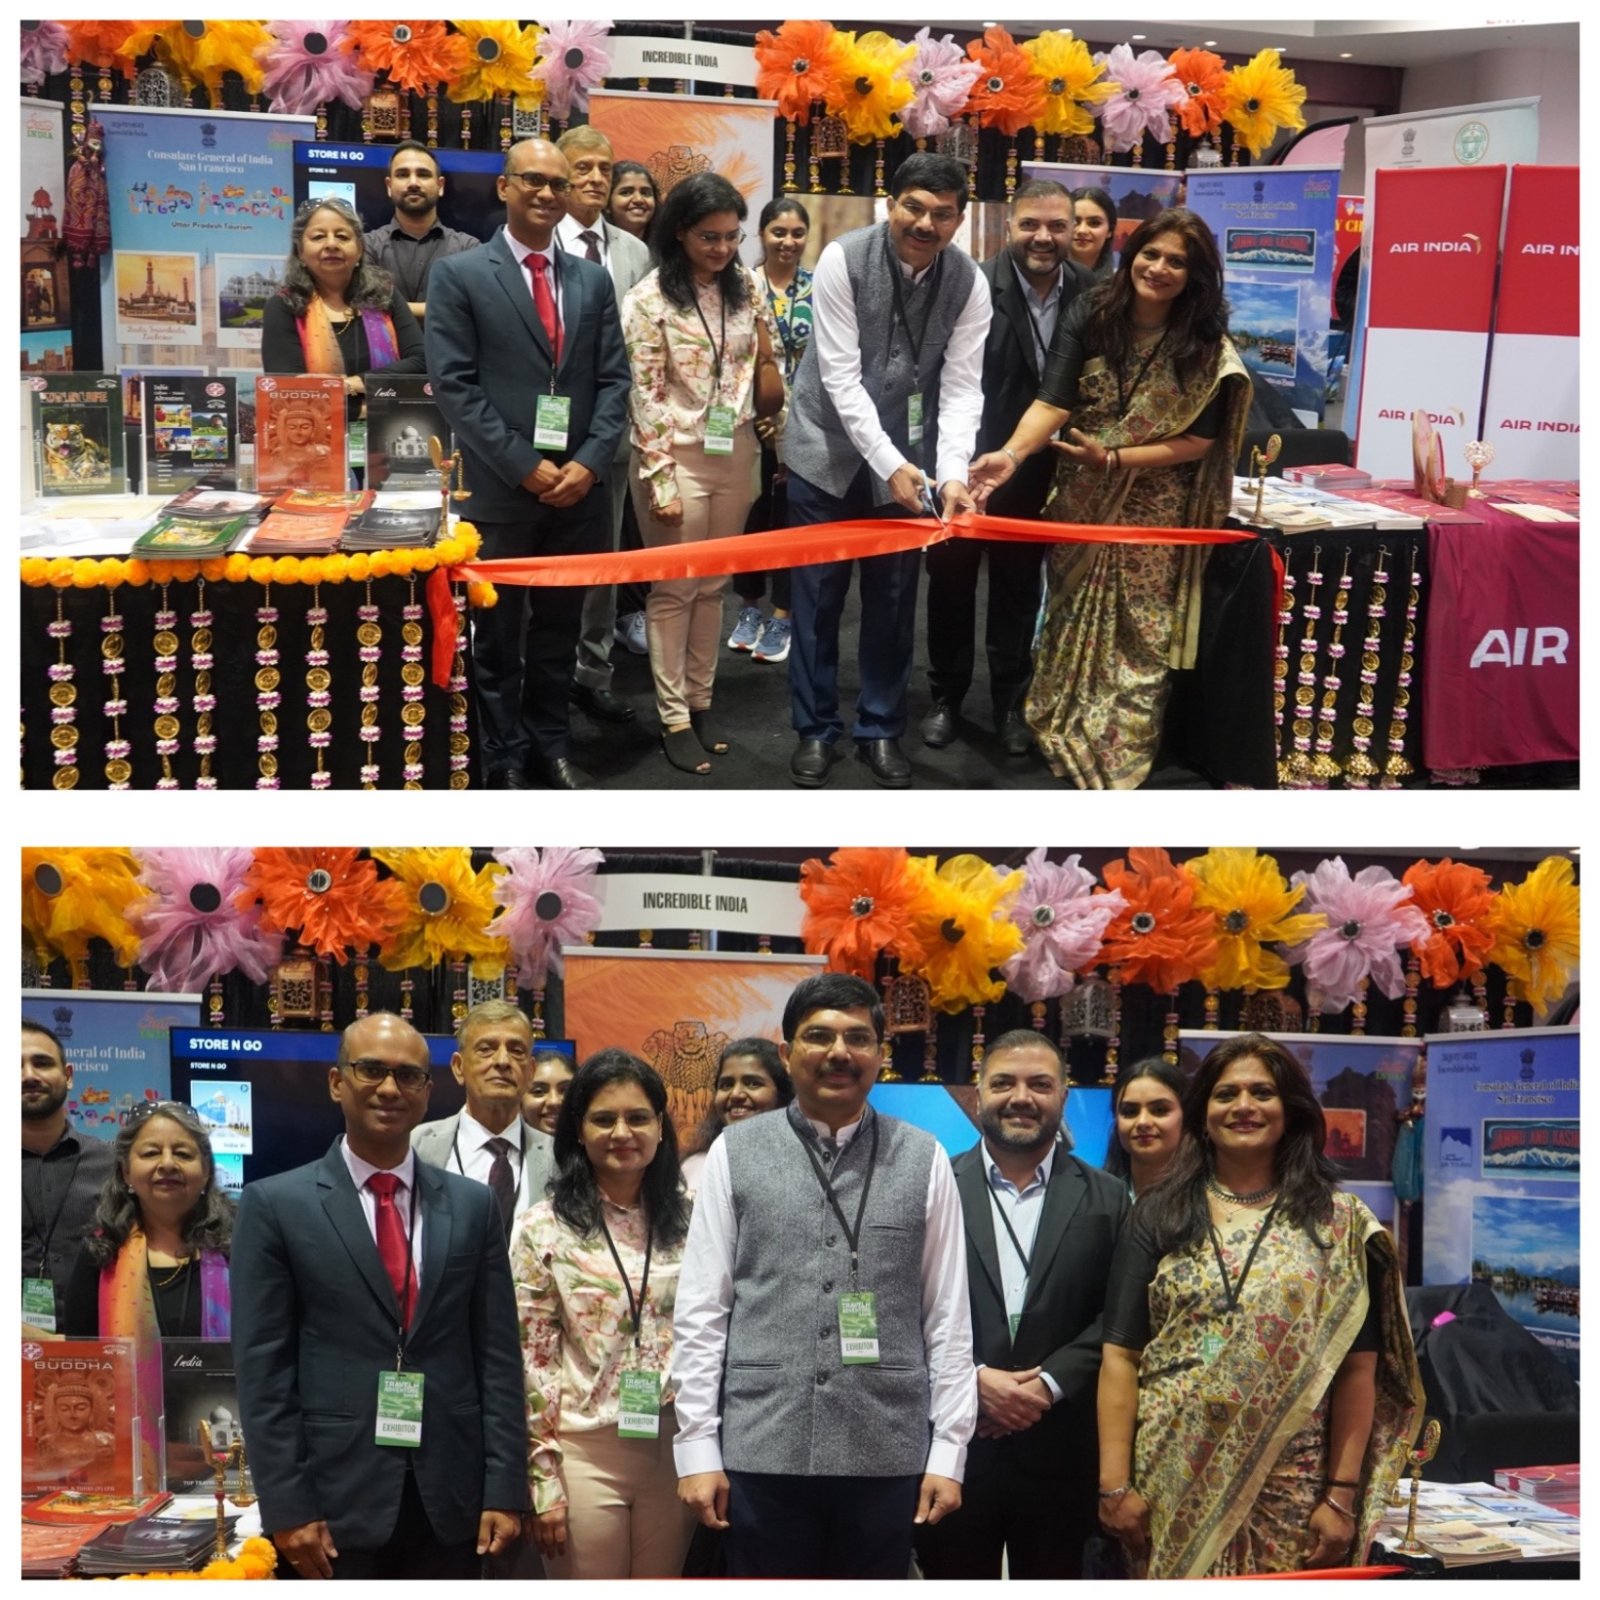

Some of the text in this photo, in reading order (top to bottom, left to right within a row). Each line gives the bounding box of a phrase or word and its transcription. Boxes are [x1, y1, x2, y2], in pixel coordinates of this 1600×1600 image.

[642, 50, 719, 68] INCREDIBLE INDIA
[147, 149, 273, 165] Consulate General of India
[308, 149, 365, 161] STORE N GO
[177, 161, 244, 174] San Francisco
[1390, 242, 1472, 253] AIR INDIA
[1521, 243, 1555, 255] AIR
[269, 391, 331, 400] BUDDHA
[1378, 409, 1456, 426] AIR IDIA
[1500, 419, 1532, 431] AIR
[1470, 627, 1570, 668] AIR
[643, 892, 749, 914] INCREDIBLE INDIA
[190, 1038, 263, 1053] STORE N GO
[64, 1047, 147, 1061] neral of India
[73, 1060, 109, 1073] ncisco
[190, 1062, 209, 1070] STORE
[216, 1063, 227, 1071] GO
[34, 1361, 114, 1371] BUDDHA
[173, 1354, 203, 1368] India
[382, 1422, 417, 1434] EXHIBITOR
